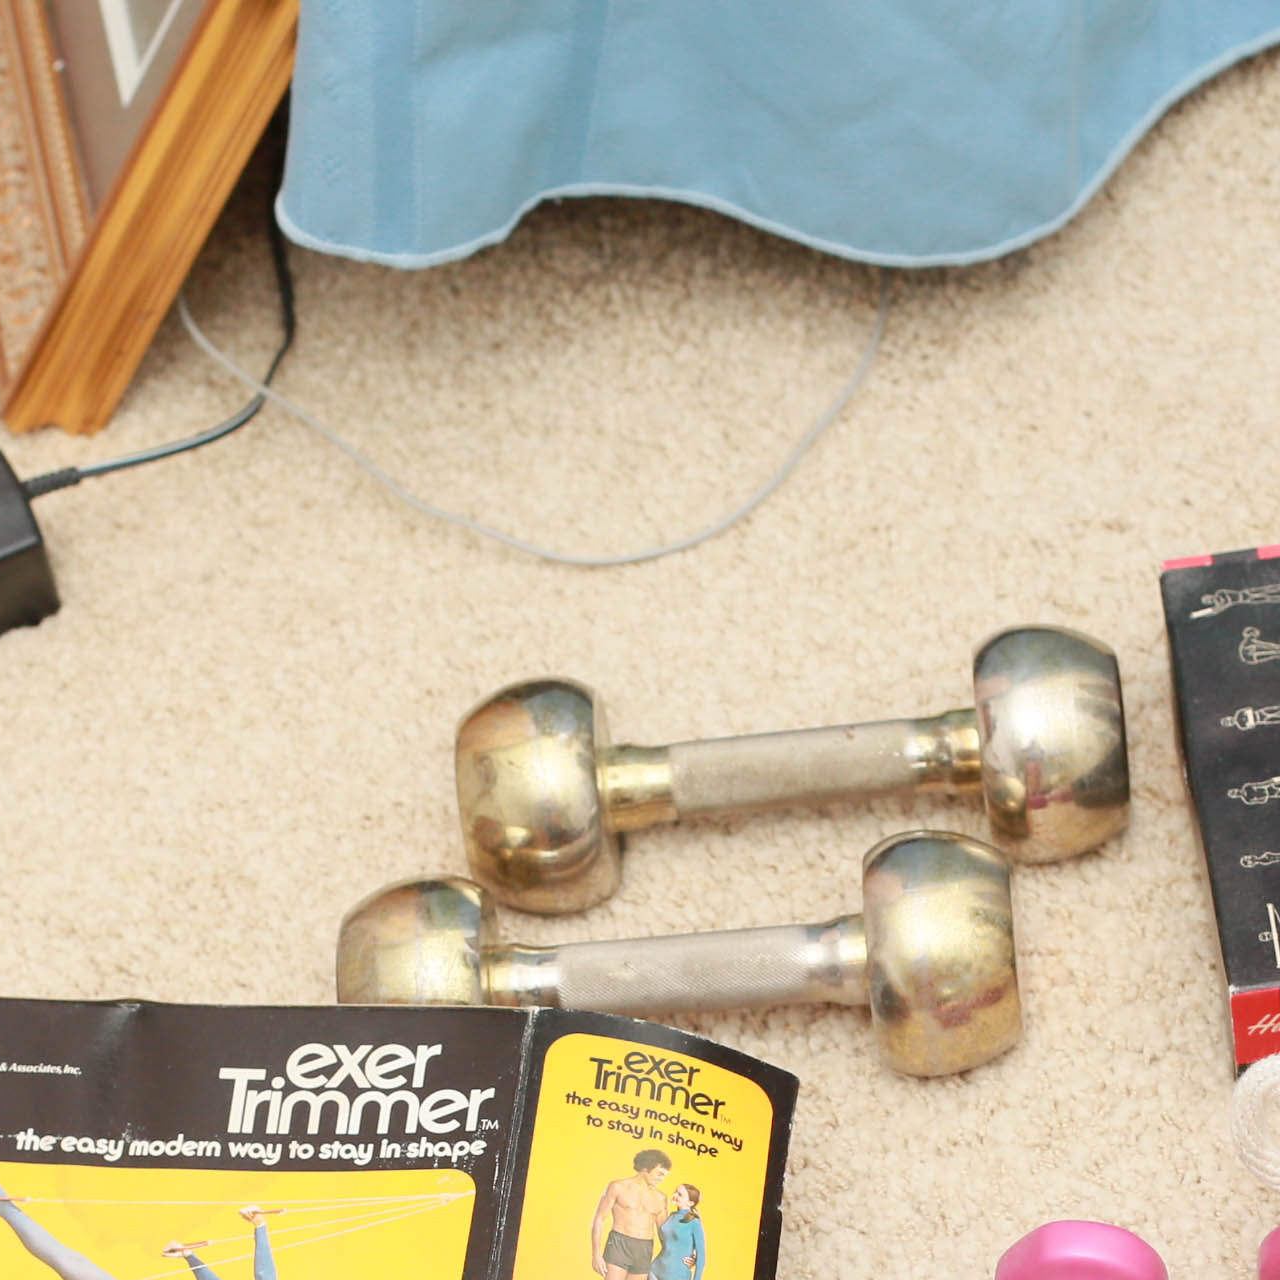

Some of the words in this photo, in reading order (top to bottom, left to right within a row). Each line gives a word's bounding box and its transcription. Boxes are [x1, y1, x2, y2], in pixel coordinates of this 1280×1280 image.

[0, 1062, 7, 1072] &
[63, 1064, 82, 1075] Inc.
[286, 1042, 442, 1089] exer
[589, 1057, 726, 1119] Trimmer
[624, 1051, 701, 1087] exer
[219, 1066, 496, 1135] Trimmer
[565, 1091, 592, 1107] the
[597, 1099, 640, 1119] easy
[645, 1108, 705, 1134] modern
[710, 1129, 743, 1151] way
[16, 1128, 56, 1153] the
[61, 1136, 123, 1162] easy
[129, 1135, 221, 1158] modern
[229, 1143, 283, 1165] way
[289, 1140, 313, 1159] to
[320, 1141, 373, 1166] stay
[379, 1138, 404, 1158] in
[406, 1137, 487, 1164] shape
[586, 1114, 603, 1127] to
[607, 1119, 644, 1139] stay
[650, 1126, 663, 1140] in
[668, 1132, 718, 1157] shape
